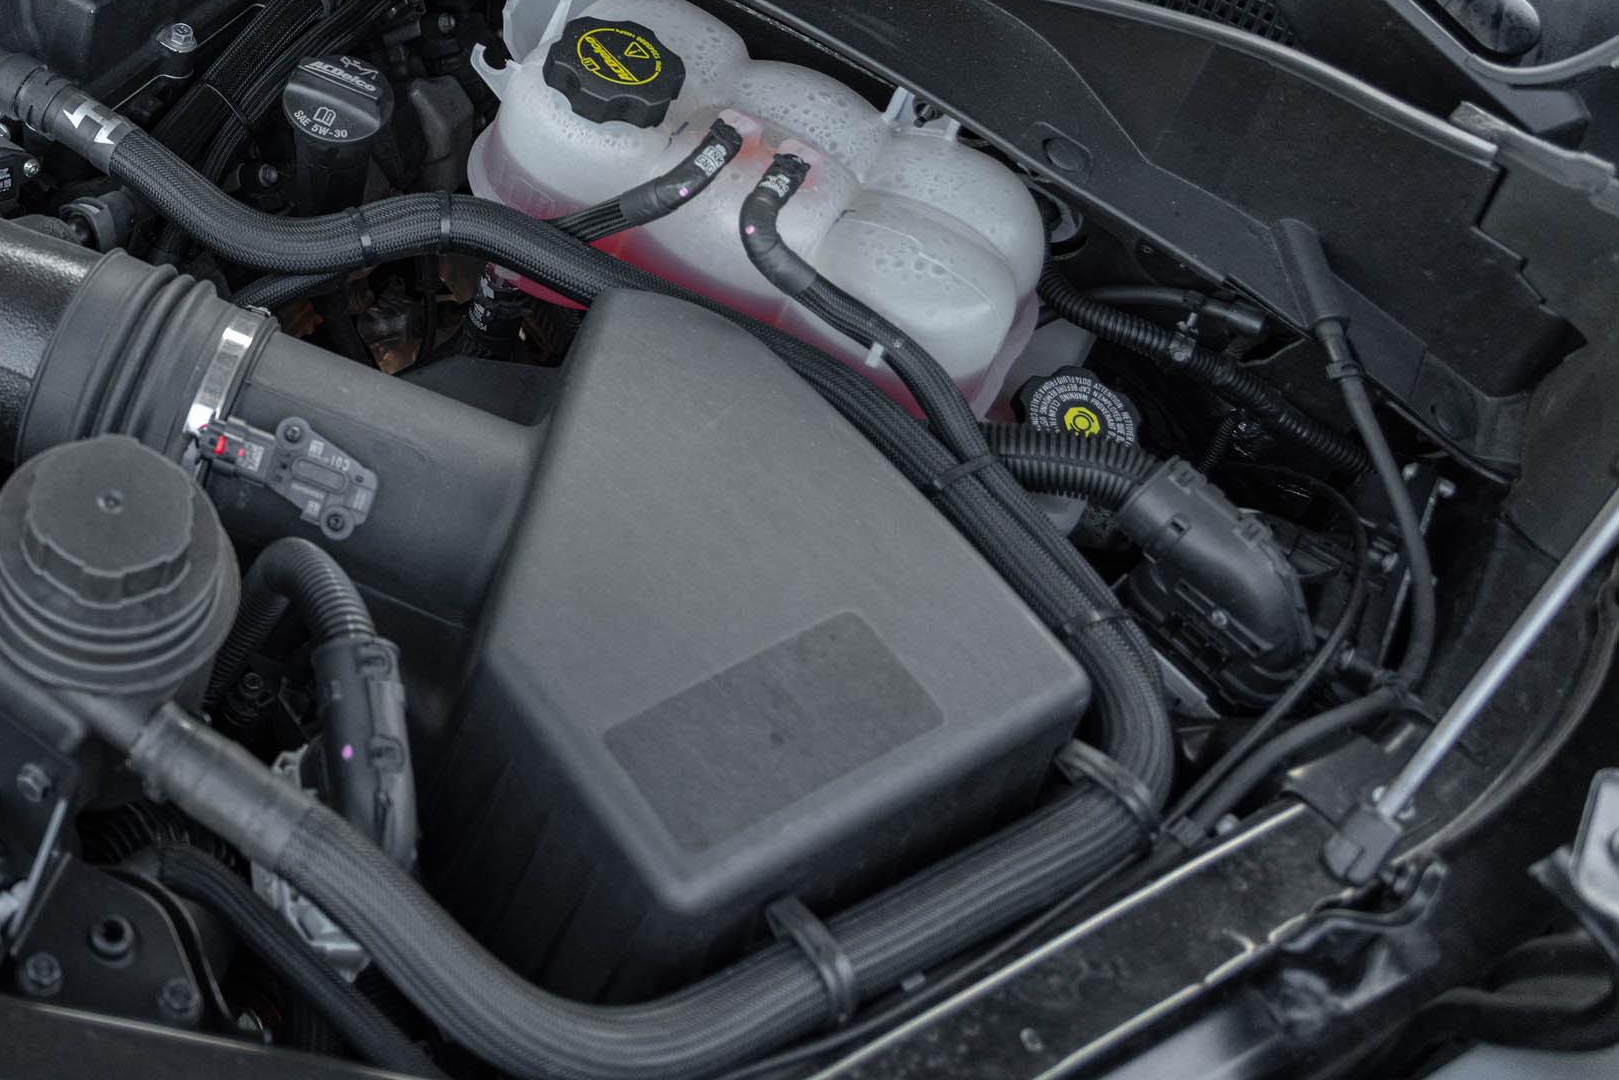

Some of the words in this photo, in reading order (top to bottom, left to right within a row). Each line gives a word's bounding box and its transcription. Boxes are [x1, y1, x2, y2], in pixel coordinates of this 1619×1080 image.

[308, 61, 377, 92] ACDelco
[293, 110, 312, 127] SAE
[311, 124, 348, 138] 5W-30
